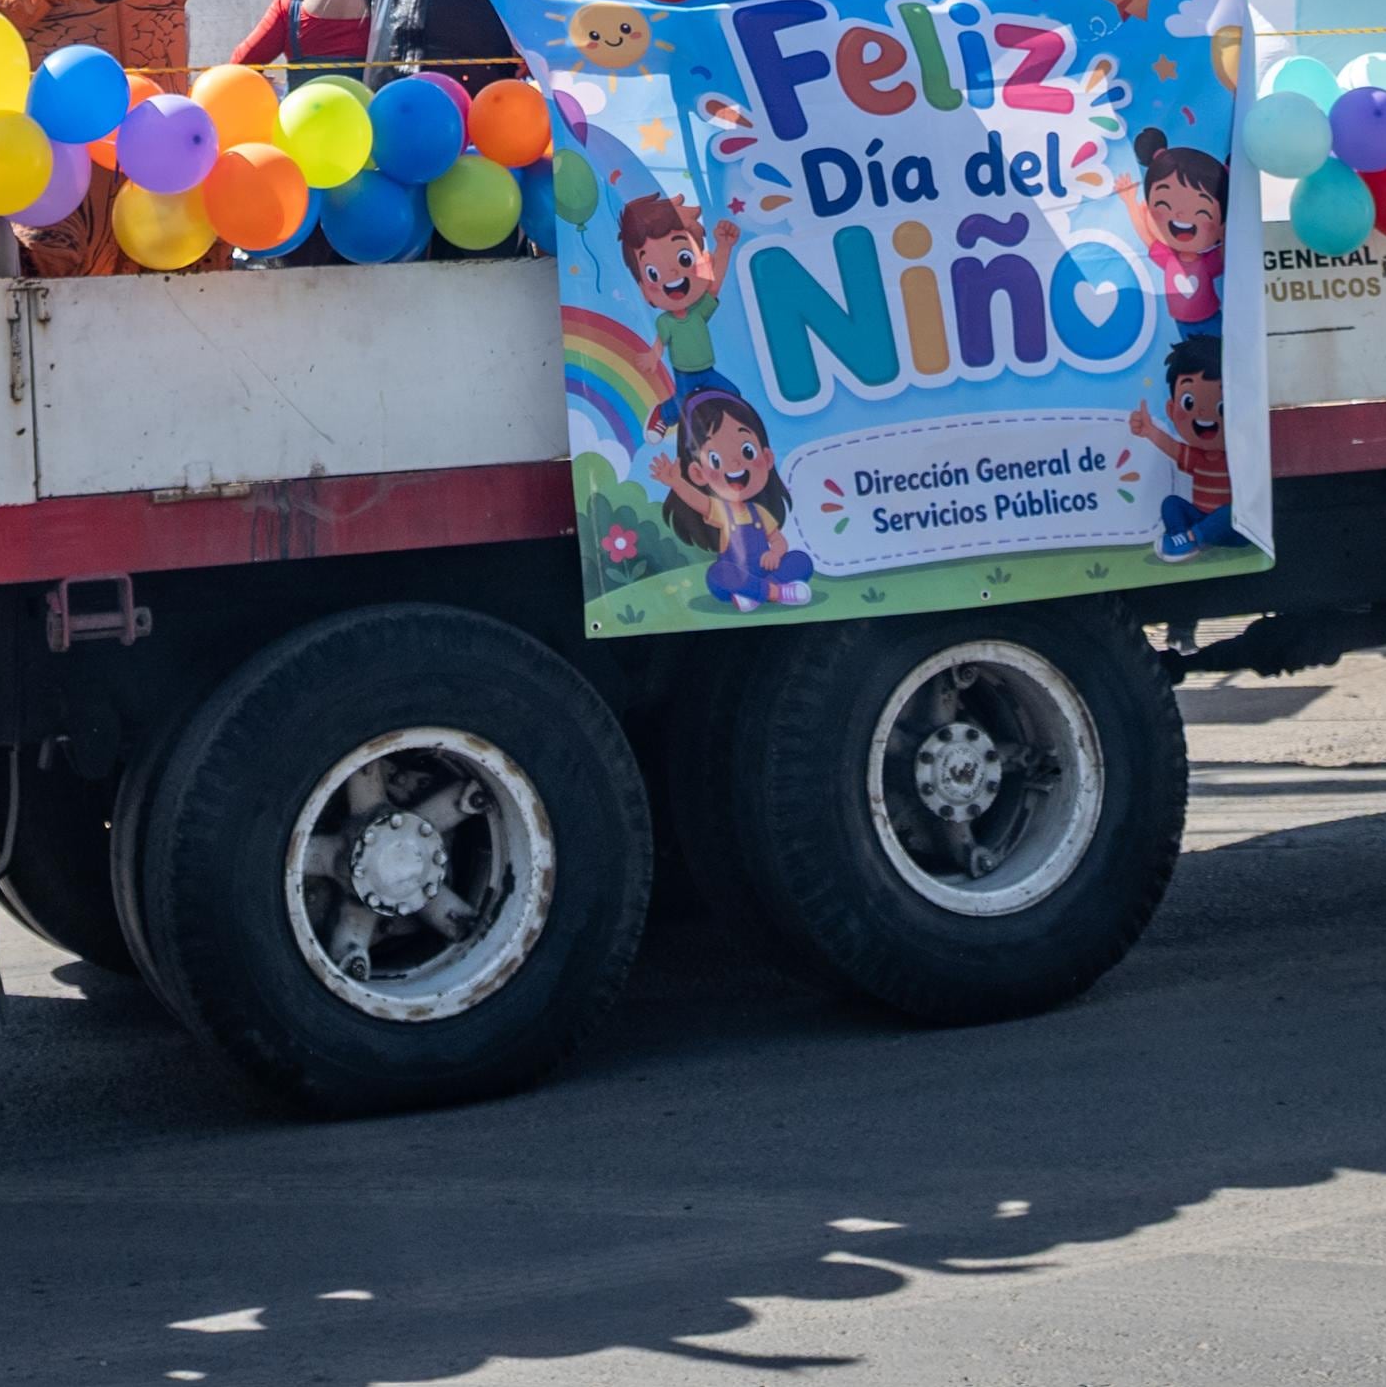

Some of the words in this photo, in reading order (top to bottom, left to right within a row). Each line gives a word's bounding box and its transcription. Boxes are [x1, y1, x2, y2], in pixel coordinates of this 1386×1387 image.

[733, 0, 1074, 141] Feliz
[801, 138, 939, 218] Día
[965, 130, 1068, 198] del
[749, 213, 1145, 403] Niño
[1265, 276, 1381, 302] ÚBLICOS
[854, 461, 969, 496] Dirección
[976, 448, 1071, 483] General
[1078, 446, 1106, 472] de
[872, 500, 988, 534] Servicios
[994, 489, 1098, 520] Públicos
